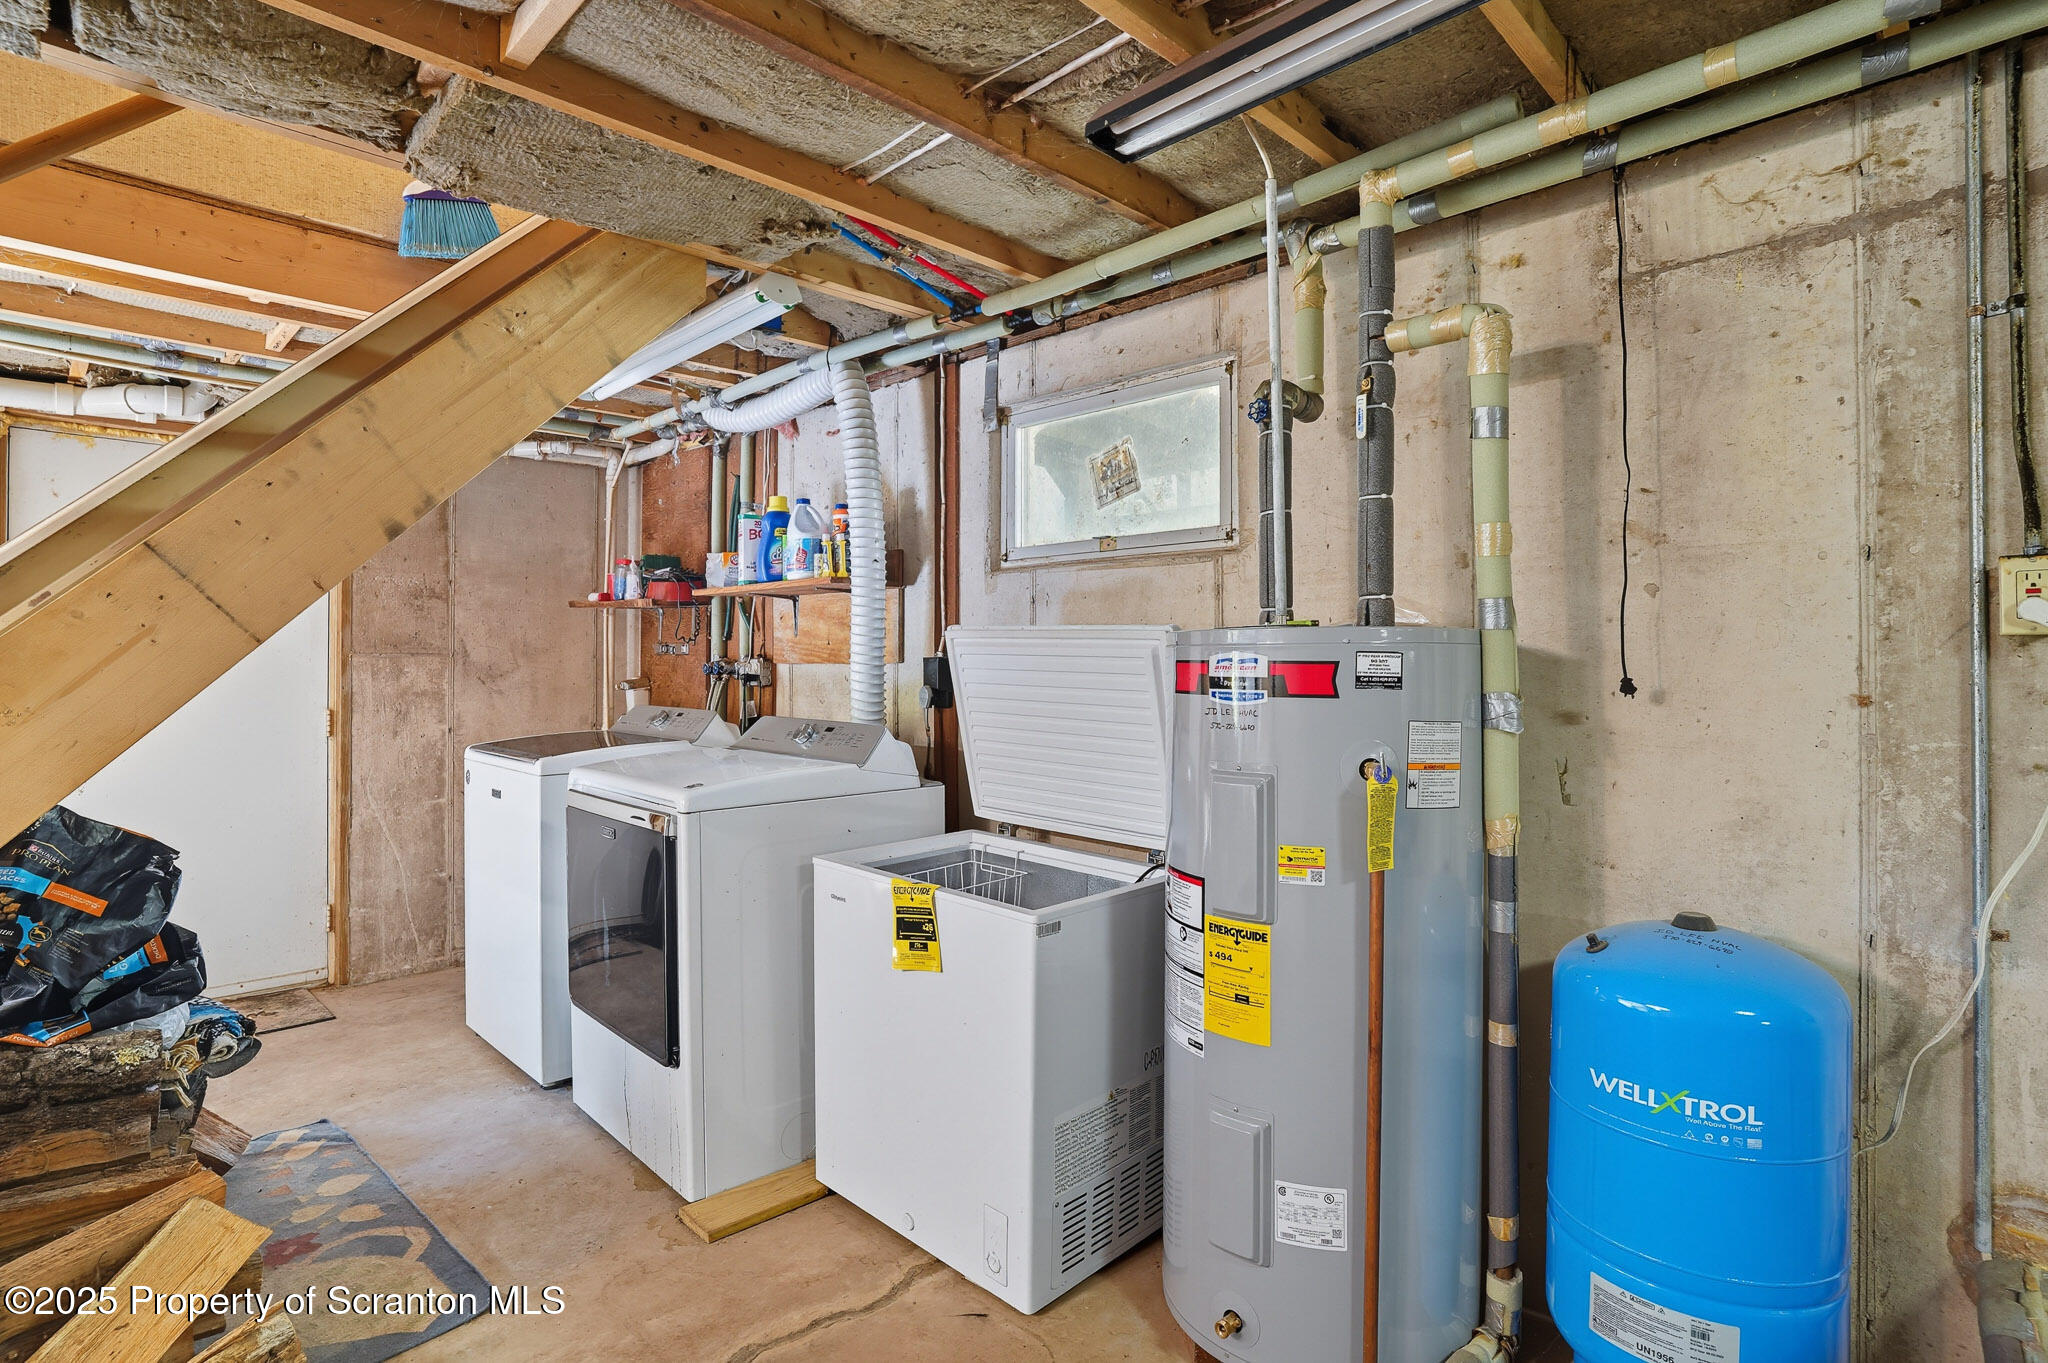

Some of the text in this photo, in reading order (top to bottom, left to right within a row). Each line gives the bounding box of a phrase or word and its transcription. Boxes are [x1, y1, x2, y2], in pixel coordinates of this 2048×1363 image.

[1209, 922, 1268, 943] ENERGYGUIDE
[1704, 1120, 1727, 1128] Above
[1636, 1341, 1675, 1363] UN1956
